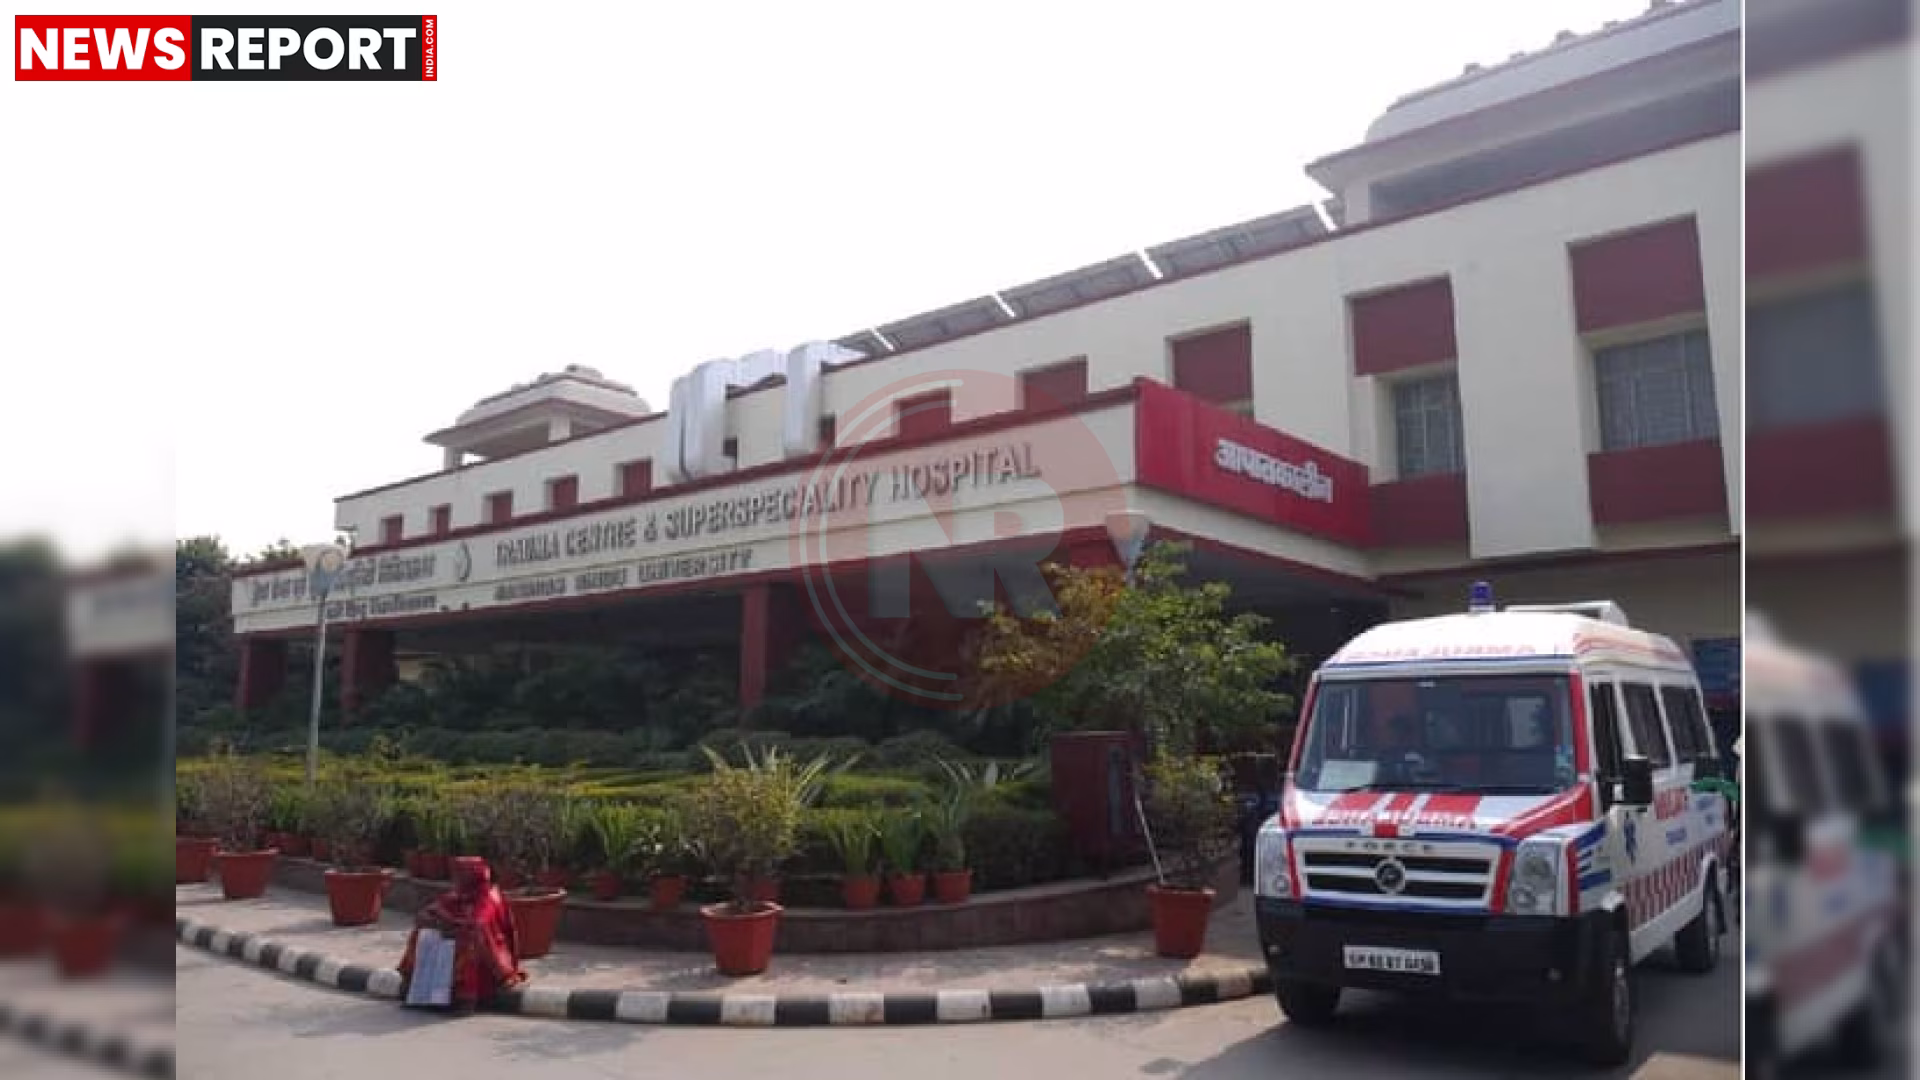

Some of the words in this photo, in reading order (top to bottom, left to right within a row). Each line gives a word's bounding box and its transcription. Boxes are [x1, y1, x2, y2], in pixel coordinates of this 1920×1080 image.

[566, 516, 637, 558] CENTRE
[664, 471, 880, 541] SUPERSPECIALITY
[890, 442, 1042, 503] HOSPITAL
[638, 549, 753, 584] UNIVERSITY
[1346, 840, 1434, 852] FORCE
